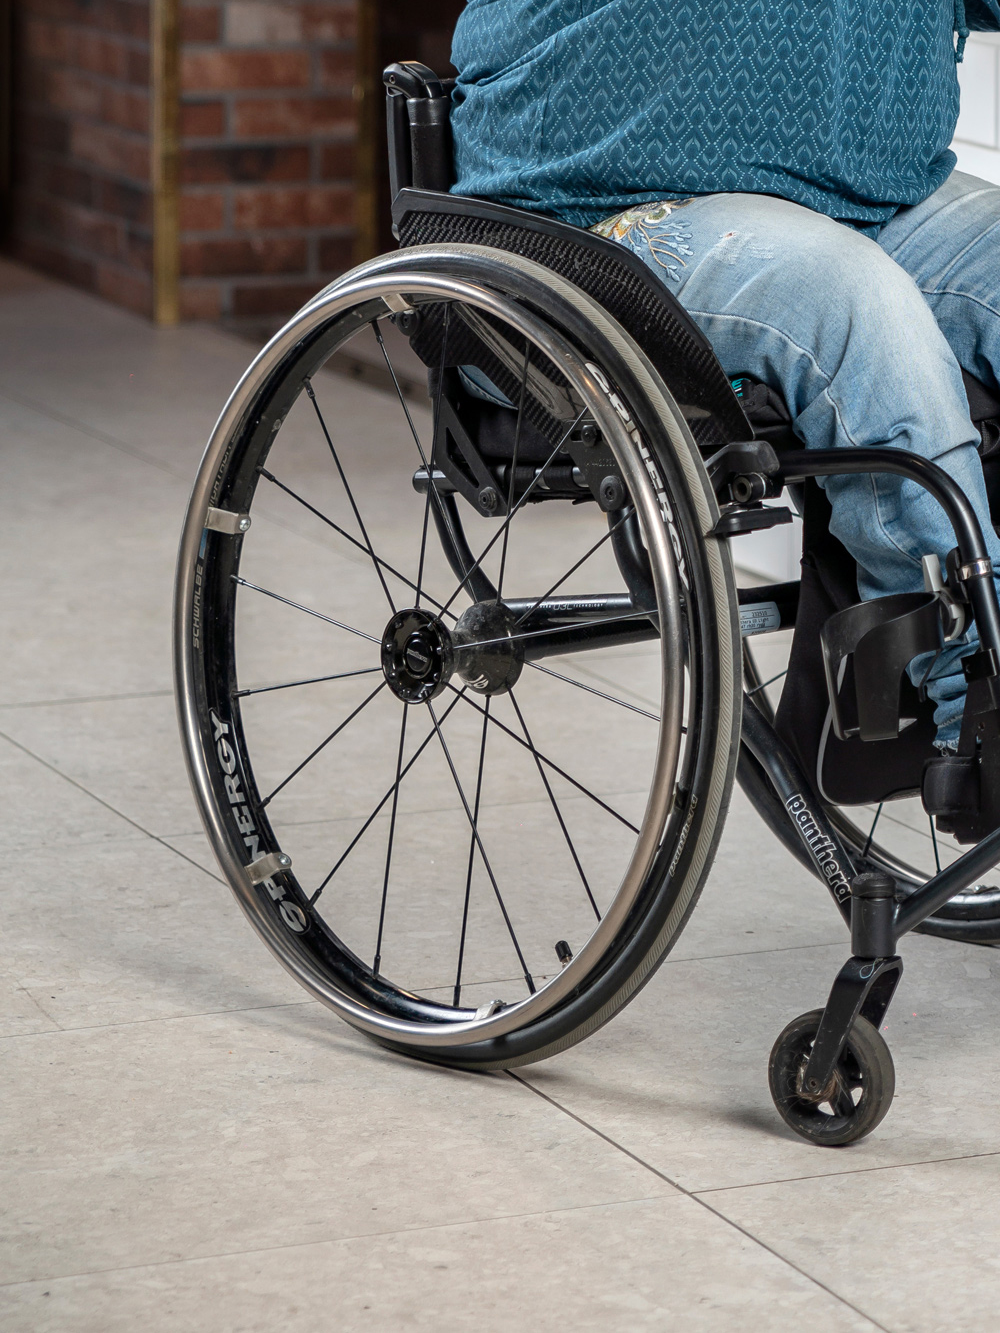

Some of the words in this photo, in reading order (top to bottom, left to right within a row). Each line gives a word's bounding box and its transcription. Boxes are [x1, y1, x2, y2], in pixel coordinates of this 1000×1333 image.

[192, 563, 204, 650] SCHWALBE
[209, 708, 308, 934] SPNERGY
[785, 793, 853, 904] panthera
